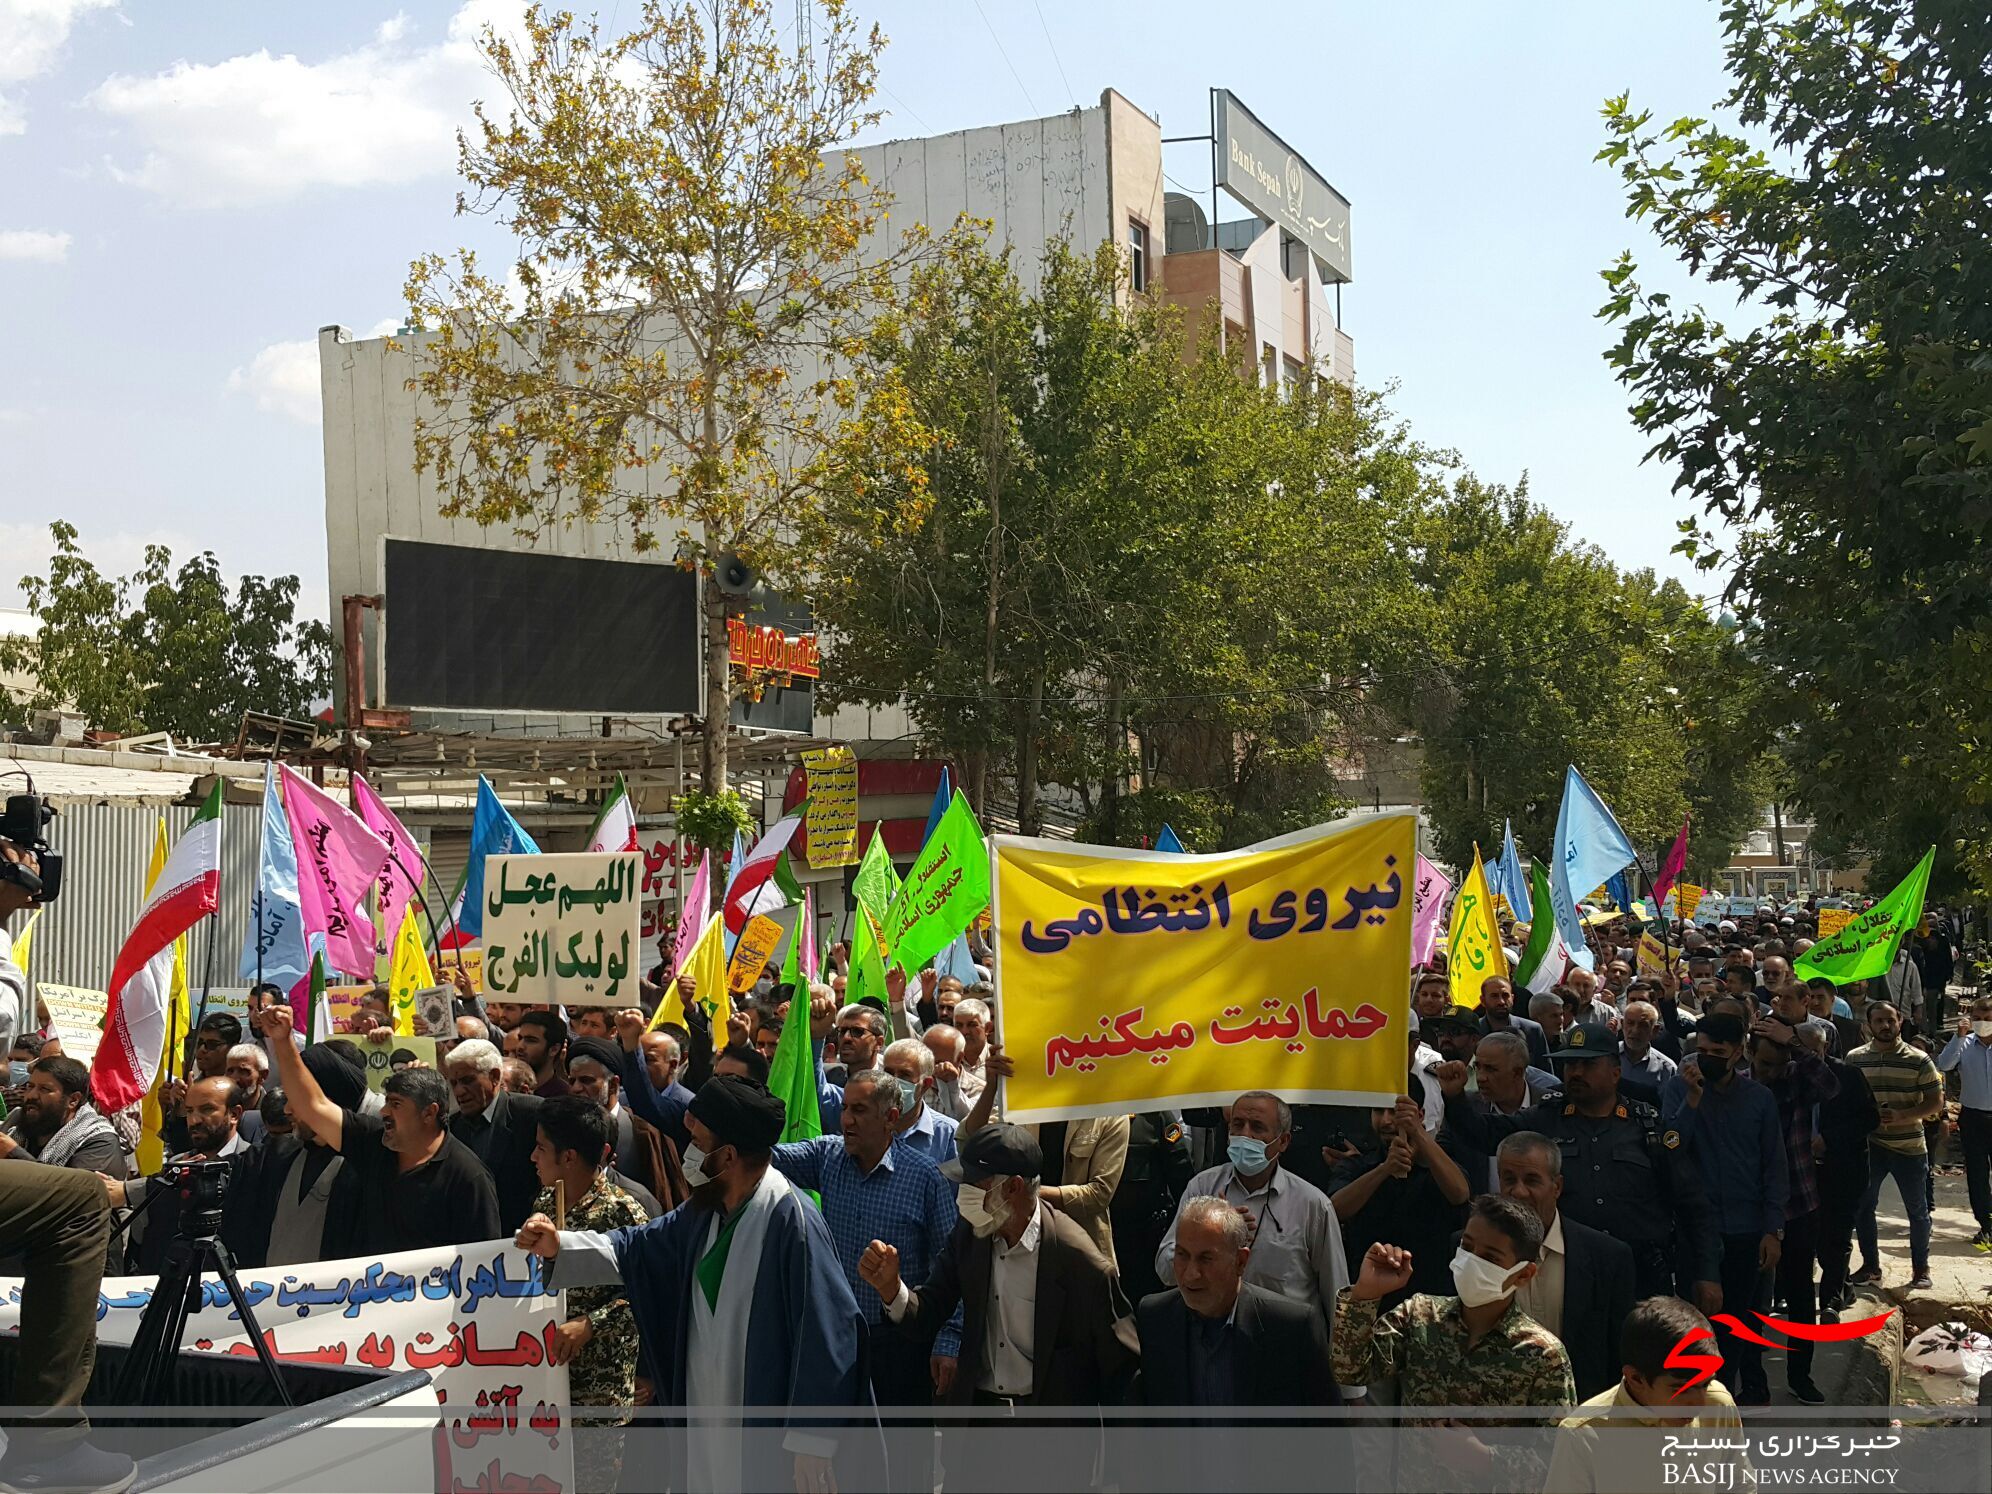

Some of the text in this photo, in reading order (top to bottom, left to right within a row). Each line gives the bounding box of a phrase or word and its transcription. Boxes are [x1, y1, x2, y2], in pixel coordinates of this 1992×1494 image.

[1231, 137, 1281, 199] Bank Sepah
[488, 860, 557, 919] عجل
[558, 857, 636, 920] اللهم
[924, 866, 964, 917] جمهوری
[1020, 880, 1232, 955] انتظامی
[1248, 854, 1403, 942] نیروی
[487, 928, 549, 994] الفرج
[196, 994, 250, 1008] یروی انتظای
[1045, 1005, 1197, 1078] میکنیم
[356, 1331, 396, 1369] به
[403, 1319, 559, 1370] اهانت
[451, 1383, 523, 1450] آتش
[529, 1399, 560, 1451] به
